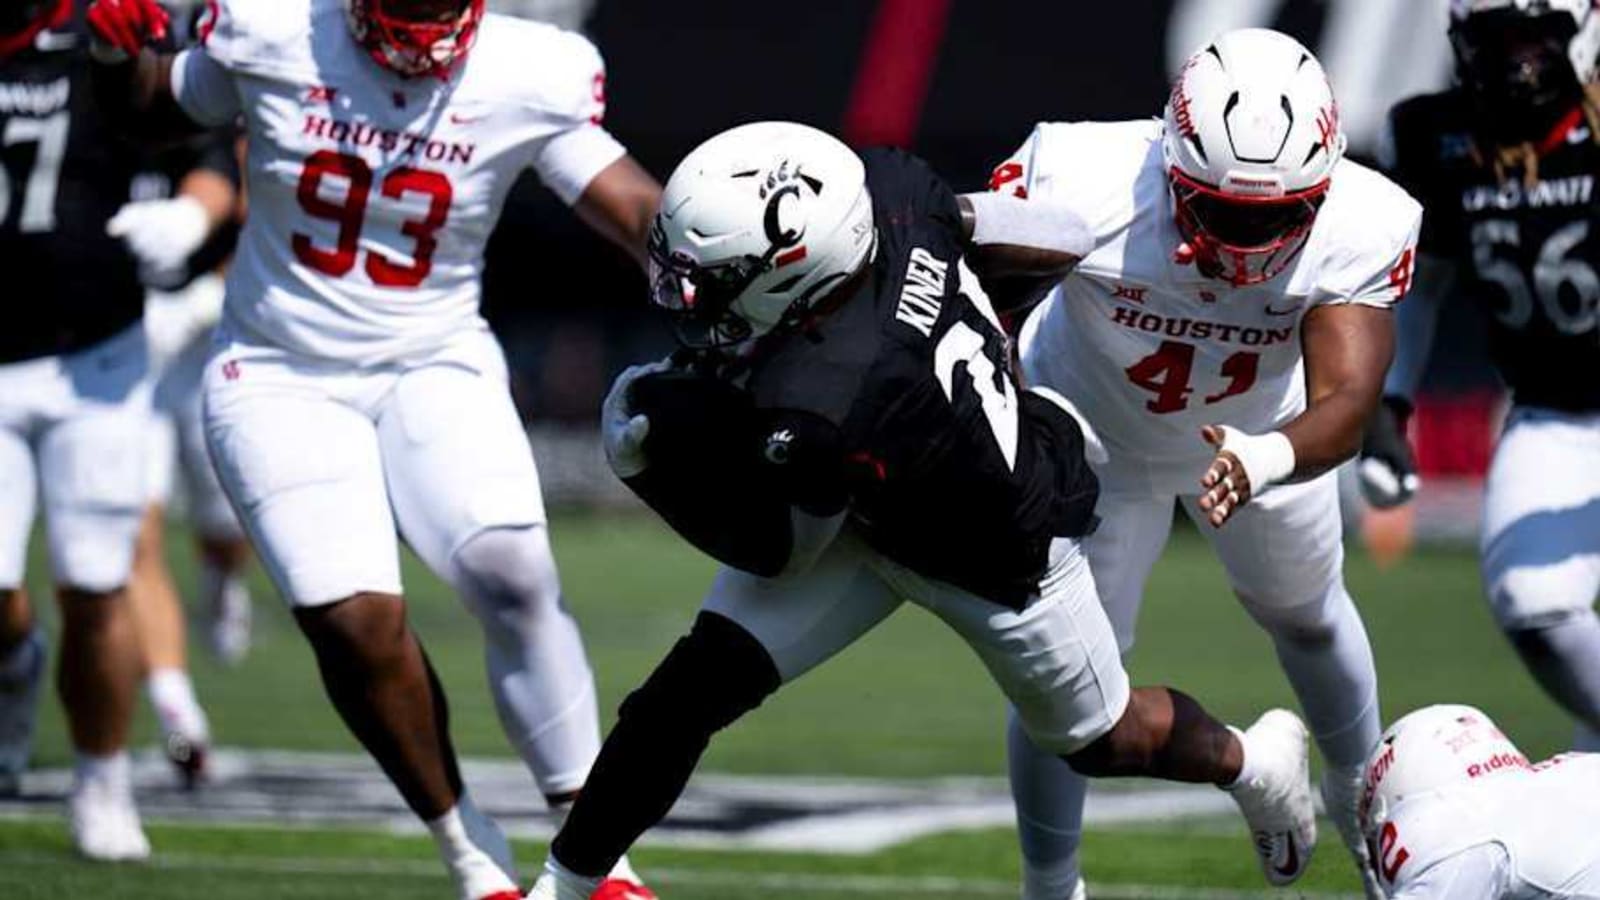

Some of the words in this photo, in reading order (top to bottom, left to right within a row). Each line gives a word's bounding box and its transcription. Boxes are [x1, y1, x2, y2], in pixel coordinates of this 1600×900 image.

[303, 114, 476, 165] HOUSTON
[291, 148, 454, 288] 93
[895, 246, 949, 339] KINER
[1470, 217, 1600, 336] 56
[1111, 306, 1294, 346] HOUSTON
[1124, 339, 1261, 415] 41
